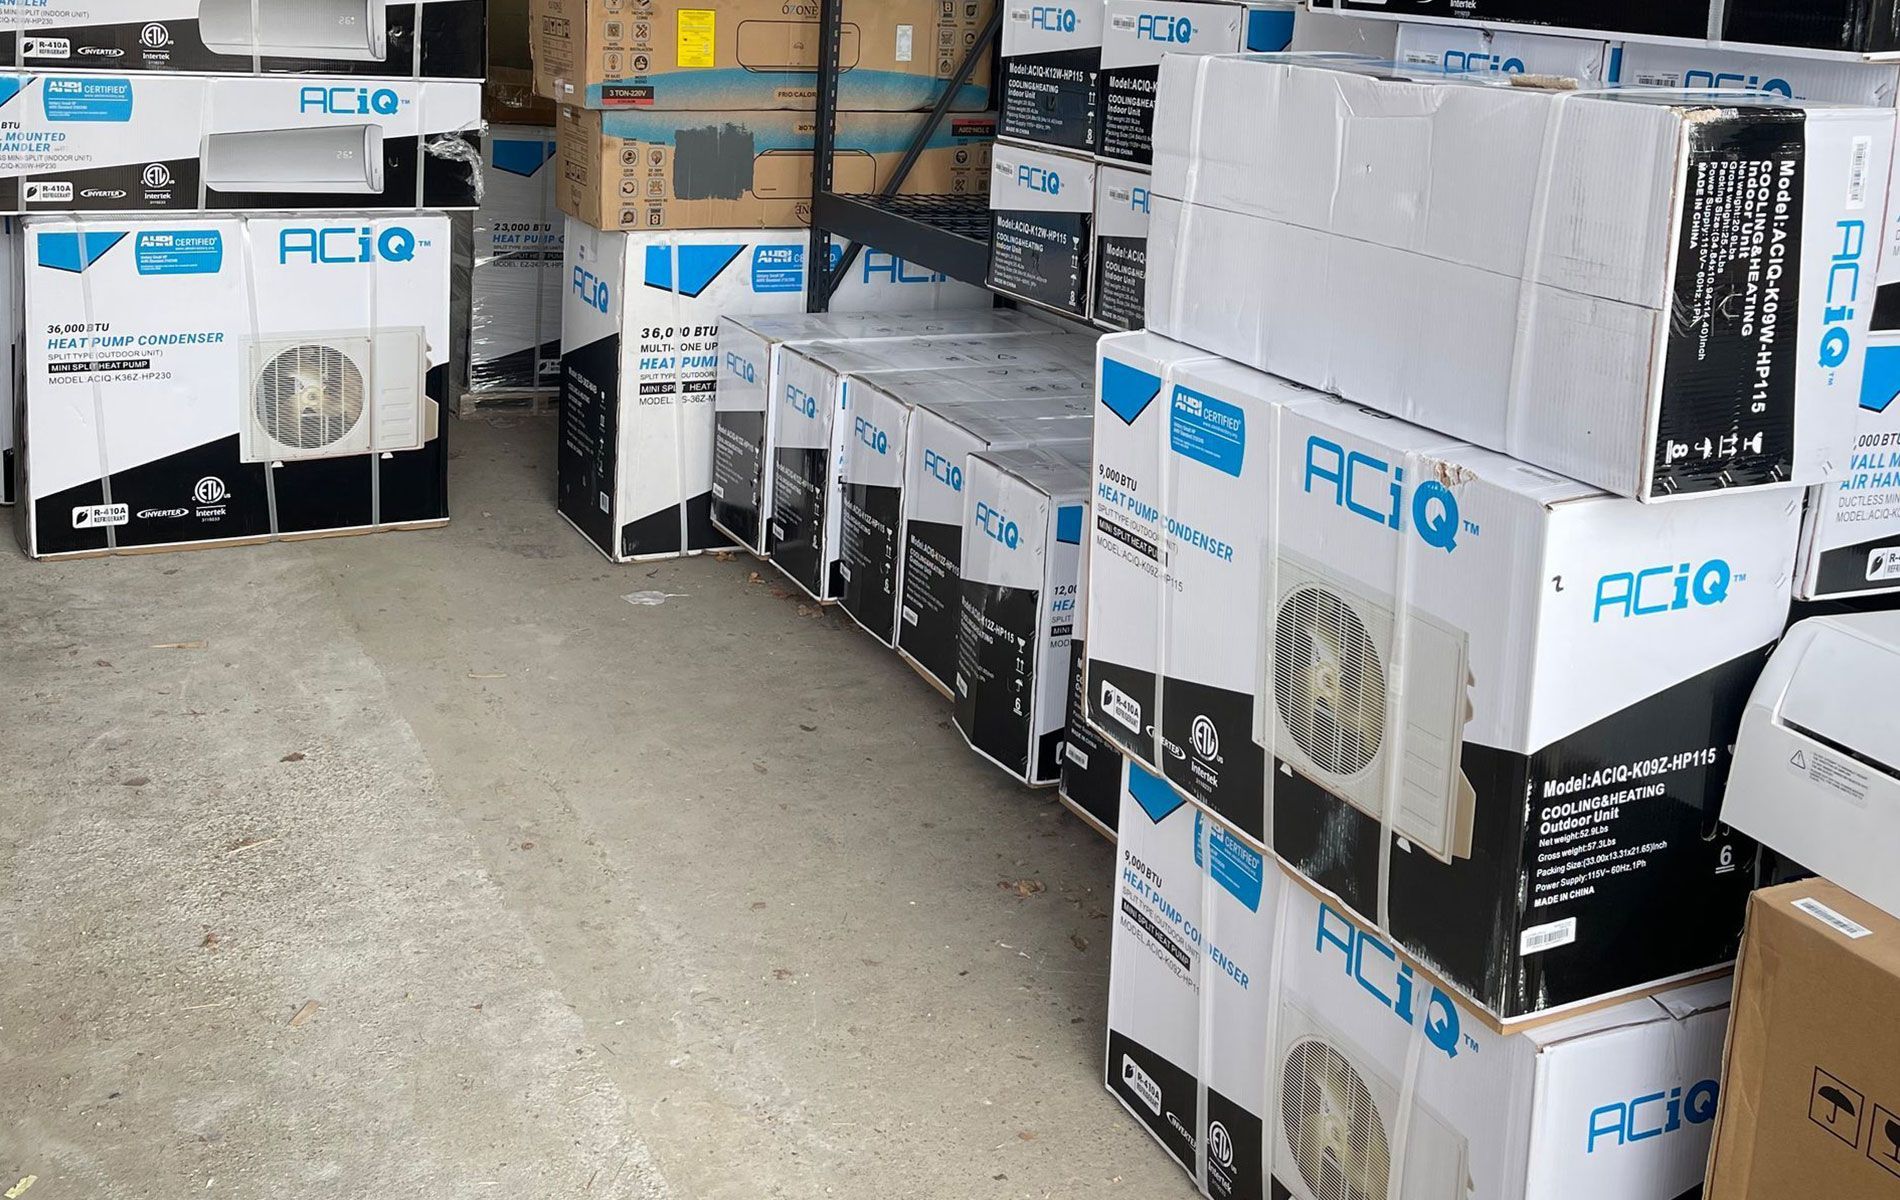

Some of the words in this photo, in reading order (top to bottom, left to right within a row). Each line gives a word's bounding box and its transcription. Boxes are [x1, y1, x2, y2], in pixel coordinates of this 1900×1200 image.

[1, 121, 21, 129] BTU
[6, 132, 66, 142] MOUNTED
[1695, 162, 1707, 196] MADE
[1706, 162, 1718, 195] Power
[1714, 162, 1729, 203] Packing
[1727, 161, 1738, 193] Gross
[1738, 161, 1748, 180] Net
[1694, 197, 1704, 210] IN
[1743, 161, 1761, 219] Indoor
[140, 235, 173, 247] AHRI
[175, 237, 216, 247] CERTIFIED
[493, 234, 521, 243] HEAT
[1689, 212, 1702, 249] CHINA
[1717, 194, 1733, 274] weight:25.4Lbs
[1738, 222, 1754, 259] Unit
[279, 226, 415, 264] ACiQ
[1741, 160, 1773, 337] COOLING&HEATING
[1751, 160, 1796, 413] Model:ACIQ-K09W-HP115
[1817, 219, 1865, 369] ACiQ
[47, 324, 84, 335] 36,000
[86, 323, 110, 332] BTU
[47, 337, 89, 350] HEAT
[91, 336, 134, 348] PUMP
[138, 332, 224, 346] CONDENSER
[640, 326, 690, 340] 36,00
[694, 325, 719, 337] BTU
[48, 353, 72, 361] SPLIT
[95, 351, 140, 359] (OUTDOOR
[141, 349, 163, 359] UNIT)
[51, 363, 70, 372] MINI
[72, 363, 98, 372] SPLIT
[99, 362, 122, 371] HEAT
[122, 360, 148, 369] PUMP
[641, 385, 660, 394] MINI
[689, 383, 711, 392] HEAT
[1175, 392, 1203, 417] AHRI
[1203, 408, 1240, 432] CERTIFIED
[1672, 443, 1689, 459] 8
[1098, 463, 1120, 484] 9,000
[1120, 473, 1138, 492] BTU
[1097, 482, 1127, 507] HEAT
[1127, 497, 1159, 524] PUMP
[1304, 435, 1460, 554] ACiQ
[1838, 494, 1884, 508] DUCTLESS
[94, 507, 126, 516] R-410A
[196, 508, 226, 517] Intertek
[1112, 525, 1131, 544] SPLIT
[1131, 534, 1148, 552] HEAT
[1593, 559, 1731, 623] ACiQ
[1051, 614, 1071, 624] SPLIT
[1053, 626, 1070, 635] MINI
[1116, 694, 1139, 718] R-410A
[1191, 760, 1219, 788] Intertek
[1543, 748, 1717, 798] Model:ACIQ-K09Z-HP115
[1541, 783, 1666, 821] COOLING&HEATING
[1540, 814, 1592, 835] Outdoor
[1593, 807, 1620, 824] Unit
[1539, 838, 1553, 848] Net
[1553, 825, 1609, 845] weight:52.9Lbs
[1538, 850, 1561, 863] Gross
[1561, 838, 1616, 858] weight:57.3Lbs
[1719, 844, 1732, 867] 6
[1124, 849, 1146, 874] 9,000
[1145, 867, 1162, 888] BTU
[1536, 864, 1565, 878] Packing
[1123, 867, 1151, 898] HEAT
[1152, 892, 1183, 925] PUMP
[1534, 895, 1559, 908] MADE
[1559, 892, 1568, 901] IN
[1569, 885, 1595, 899] CHINA
[1535, 880, 1560, 893] Power
[1316, 902, 1460, 1059] ACiQ
[1137, 1071, 1160, 1101] R-410A
[1587, 1079, 1720, 1153] ACiQ
